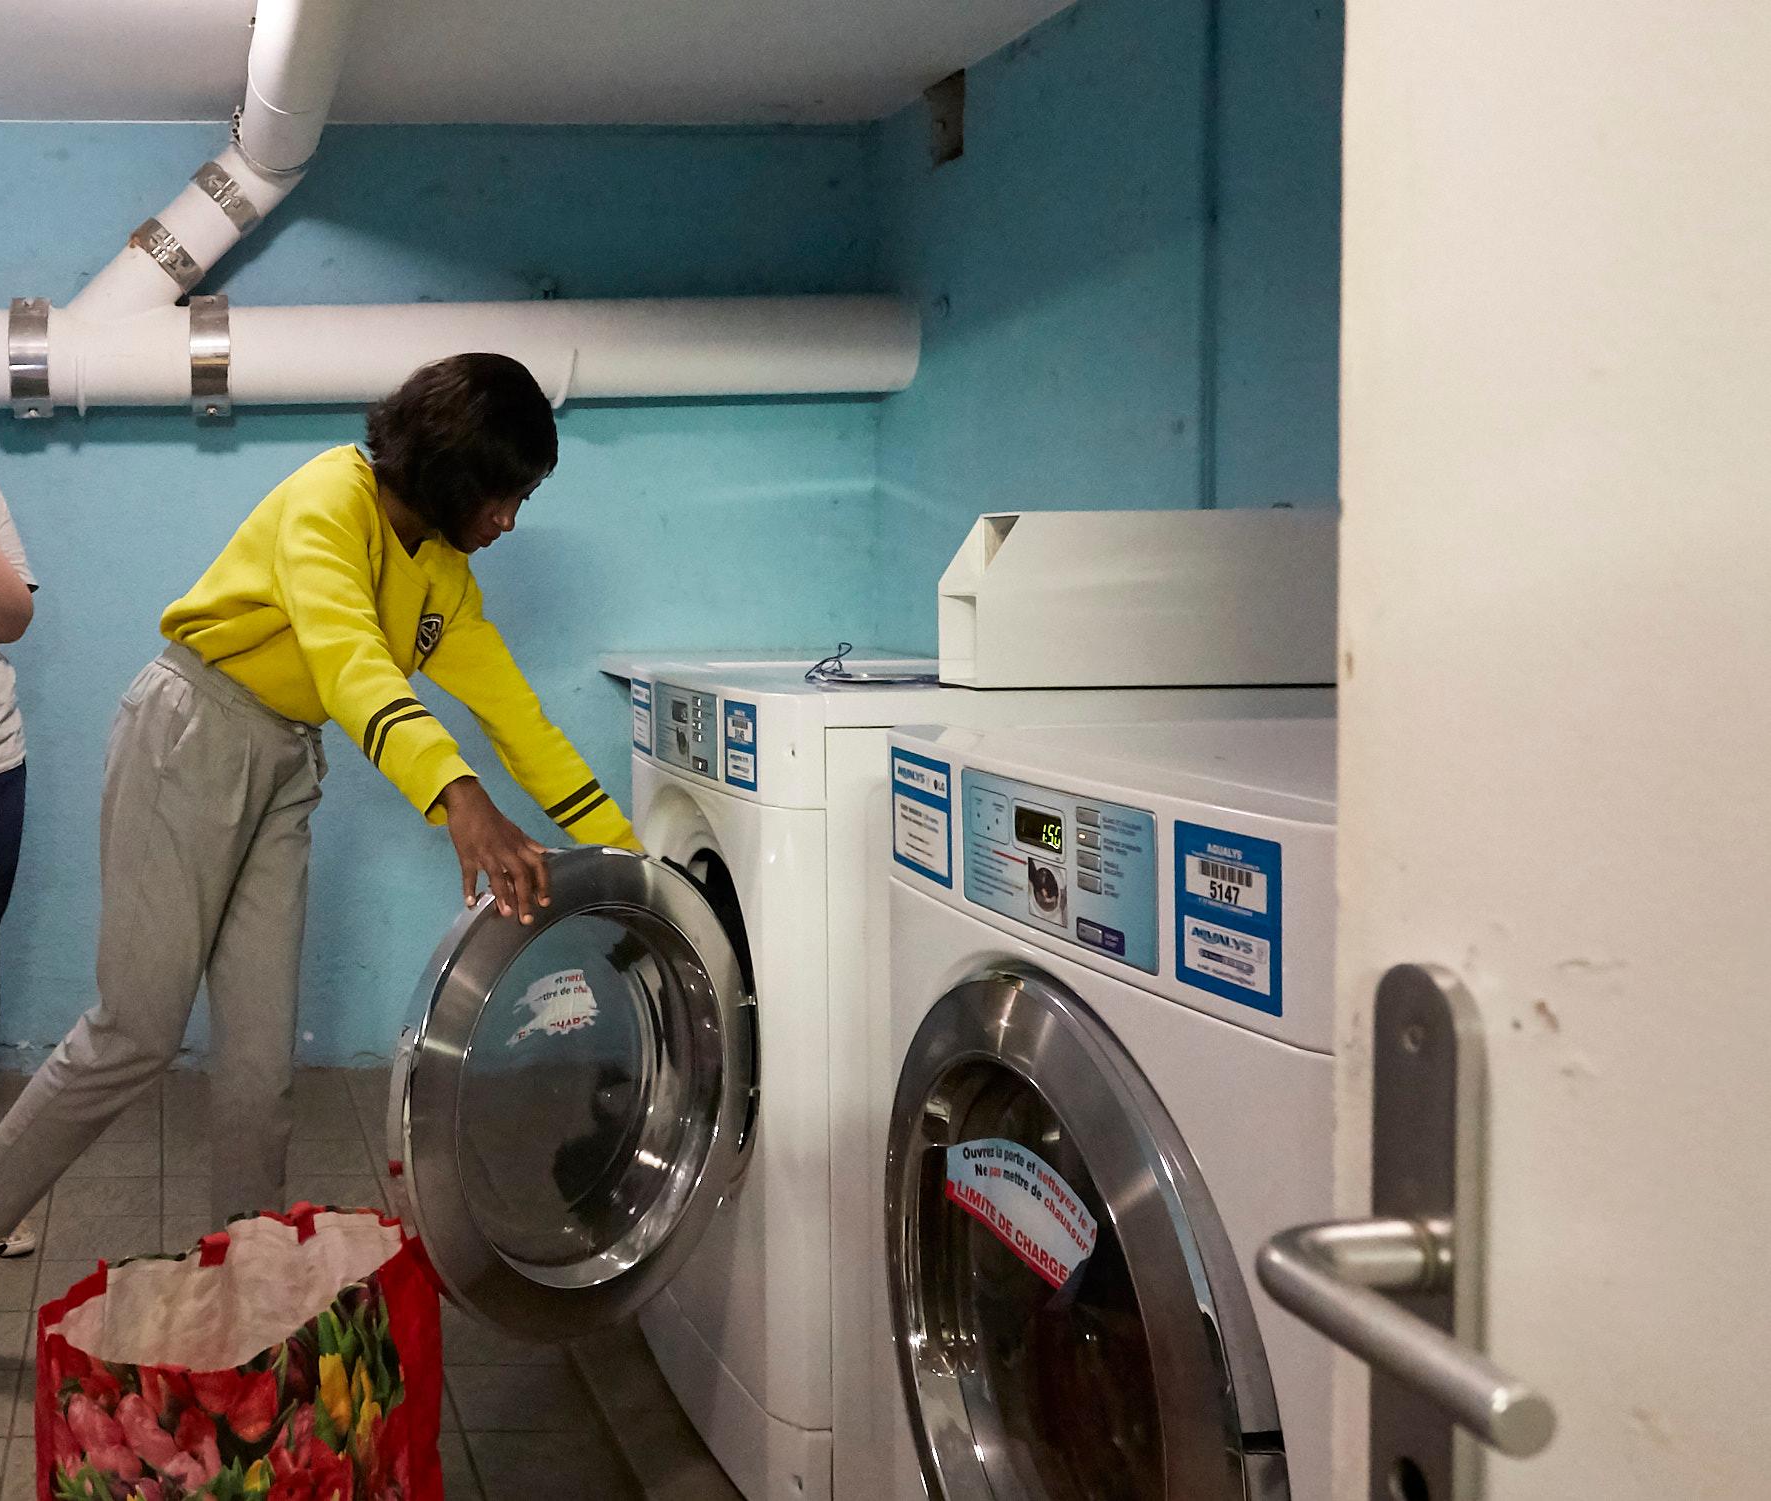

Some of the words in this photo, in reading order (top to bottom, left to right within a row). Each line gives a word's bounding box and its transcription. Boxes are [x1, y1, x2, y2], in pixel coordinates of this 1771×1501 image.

[1209, 880, 1240, 905] 5147
[962, 1146, 995, 1160] Ouvrez
[1004, 1149, 1025, 1167] porte
[1026, 1161, 1036, 1175] et
[1037, 1168, 1078, 1216] nettoyez
[1078, 1209, 1089, 1231] le
[974, 1163, 988, 1177] Ne
[1003, 1169, 1029, 1190] mettre
[1031, 1182, 1043, 1201] de
[957, 1179, 997, 1222] LIMITE
[998, 1212, 1013, 1237] DE
[1015, 1229, 1070, 1282] CHARGE
